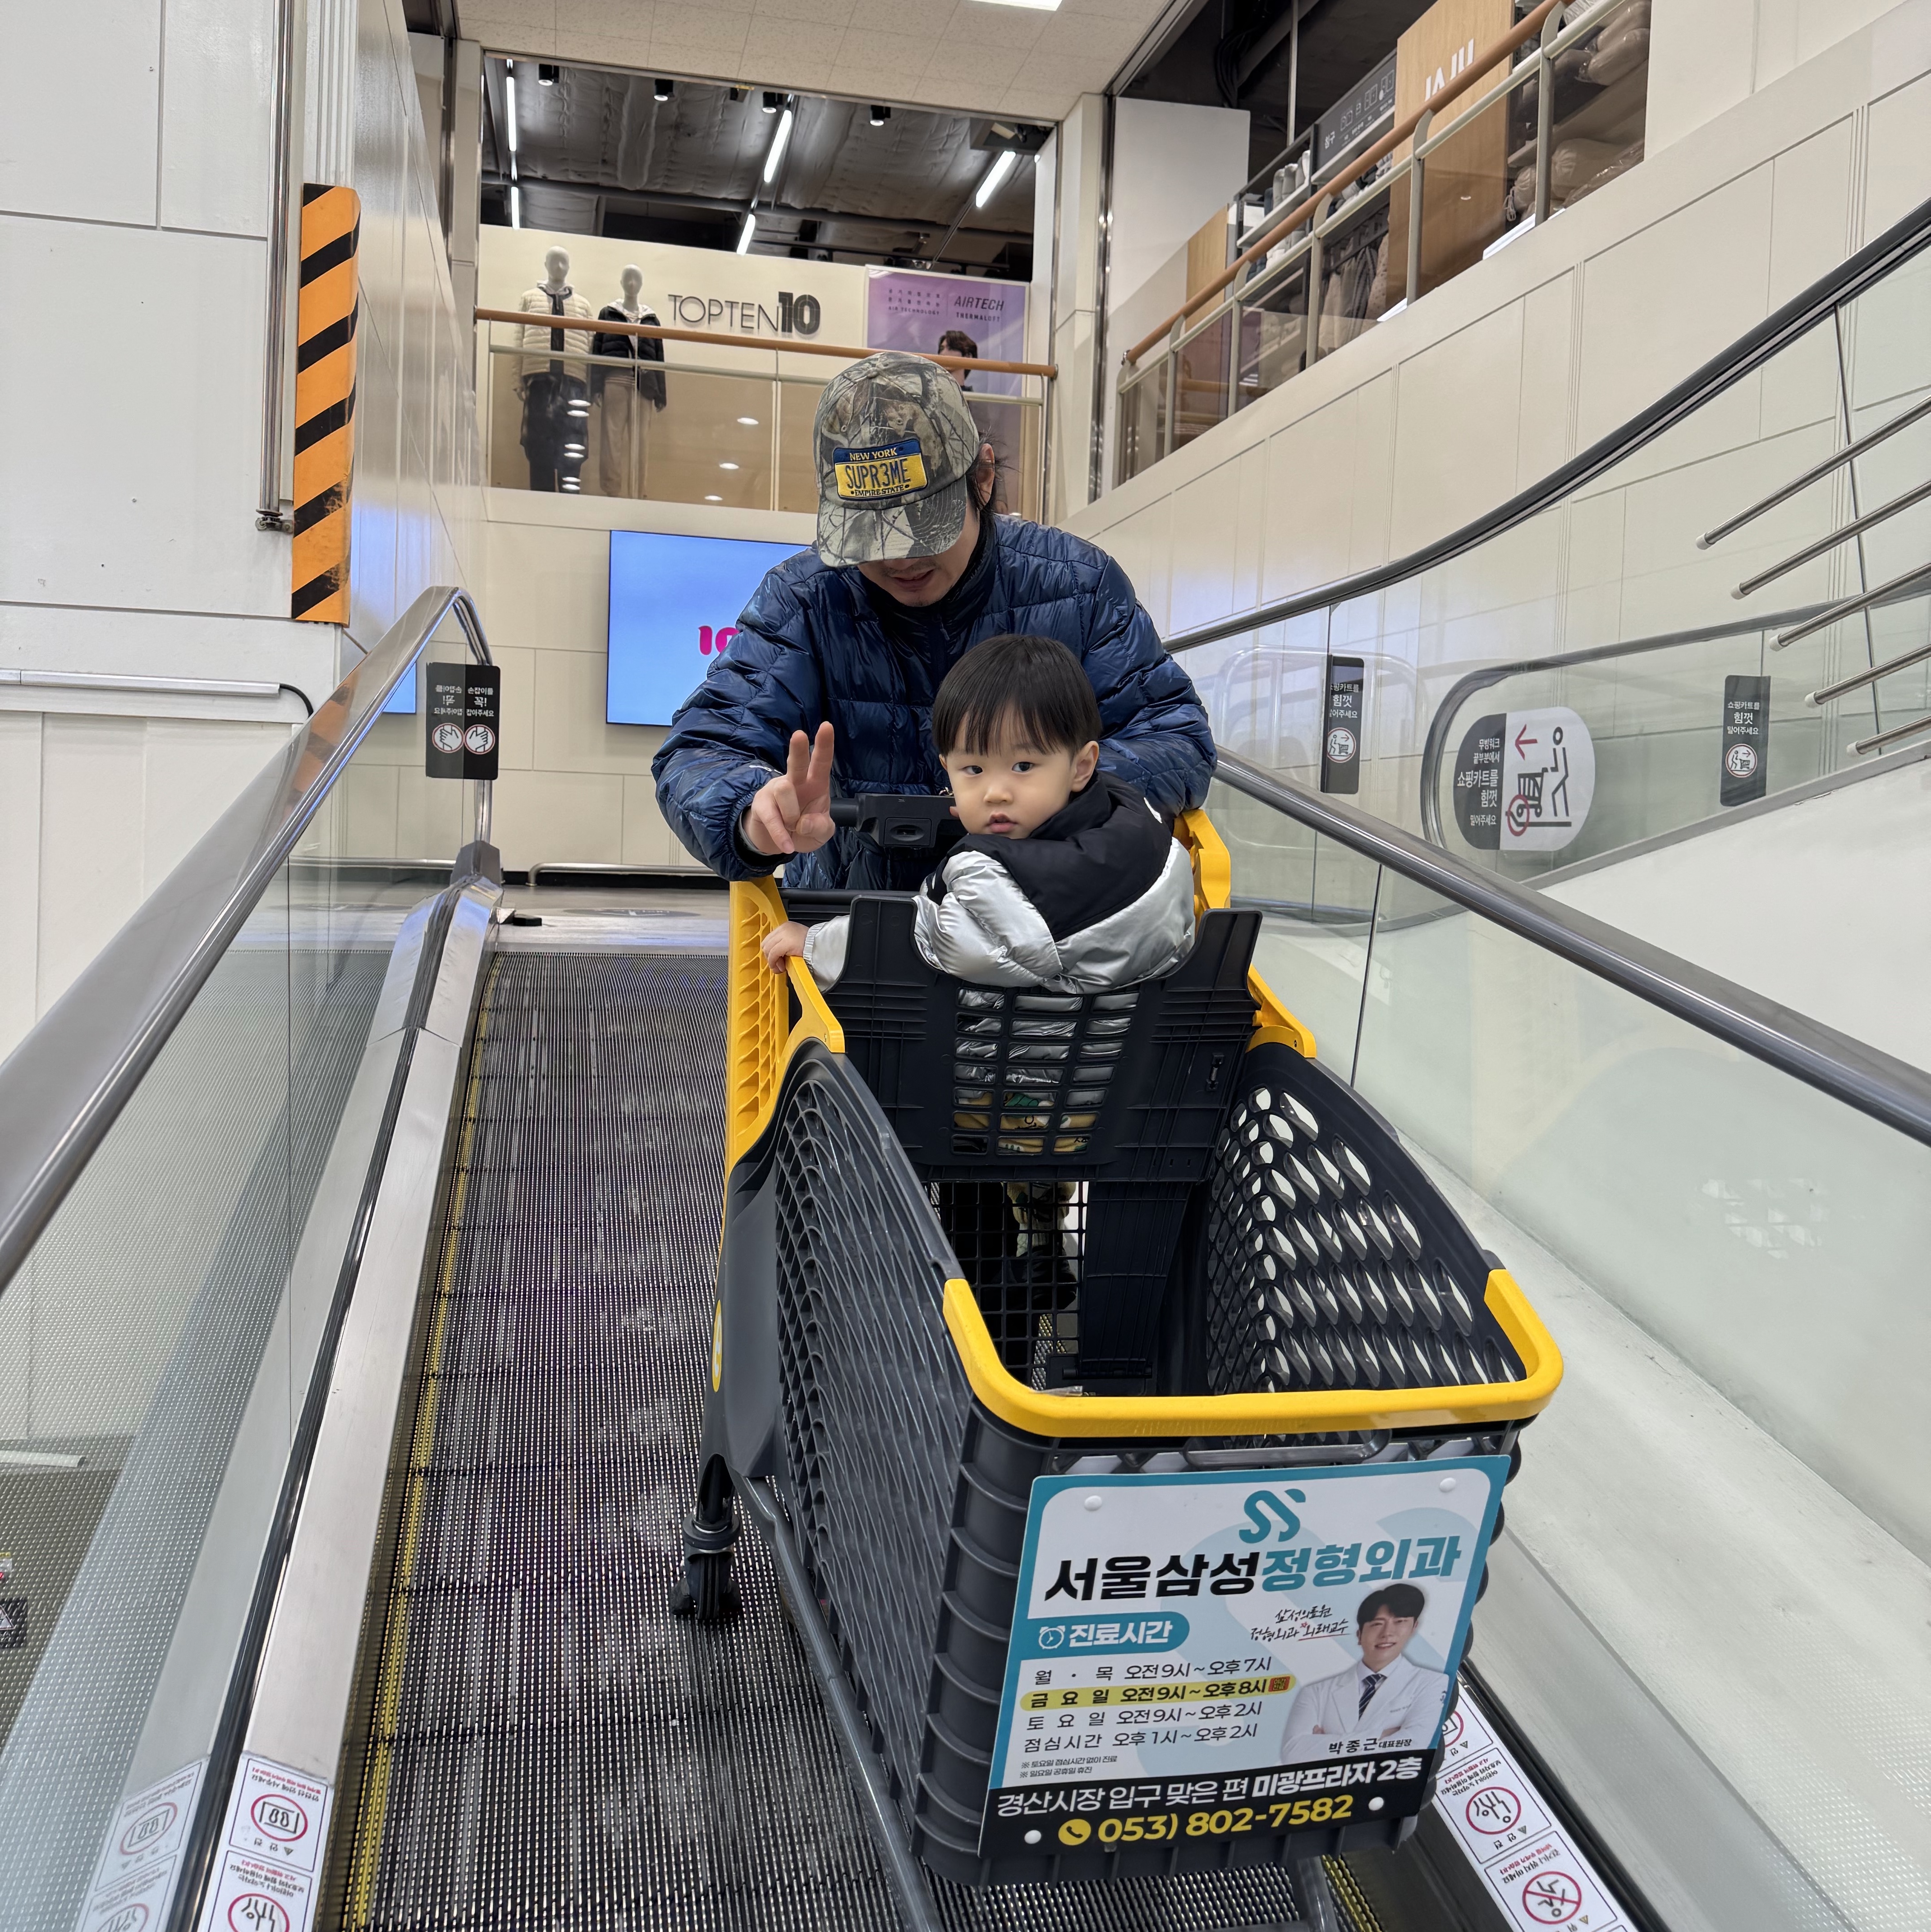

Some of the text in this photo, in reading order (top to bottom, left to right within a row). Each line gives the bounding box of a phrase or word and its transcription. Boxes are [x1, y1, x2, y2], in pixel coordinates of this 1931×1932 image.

[954, 296, 1004, 311] AIRTECH
[668, 291, 821, 335] TOPTEN10
[956, 312, 1000, 322] THERMALOFT
[850, 447, 897, 461] NEW YORK
[845, 458, 911, 489] SUPR3ME
[468, 687, 493, 695] 손잡이를
[474, 697, 487, 707] 꼭!
[1333, 694, 1352, 708] 힘껏
[1728, 702, 1760, 710] 쇼핑카트를
[466, 709, 494, 717] 잡아주세요
[1734, 712, 1753, 725] 힘껏
[1727, 726, 1758, 735] 밀어주세요
[1478, 738, 1500, 750] 무빙워크
[1473, 752, 1500, 764] 끝부분에서
[1457, 769, 1498, 788] 쇼핑카트를
[1481, 789, 1497, 807] 힘껏
[1470, 814, 1496, 826] 밀어주세요
[1275, 1604, 1333, 1624] 삼성의료원
[1069, 1620, 1172, 1647] 진료시간
[1251, 1627, 1299, 1642] 정형외과
[1035, 1670, 1052, 1685] 월
[1096, 1666, 1113, 1681] 목
[1025, 1734, 1102, 1753] 점심시간
[1378, 1739, 1412, 1748] 대표원장
[1031, 1760, 1054, 1768] 토요일
[1055, 1758, 1085, 1766] 점심시간
[1480, 1759, 1501, 1774] 보호자와
[1030, 1769, 1052, 1777] 일요일
[1054, 1767, 1076, 1775] 공휴일
[1475, 1769, 1498, 1784] 어린이나
[998, 1788, 1105, 1817] 경산시장
[1109, 1785, 1161, 1809] 입구
[1252, 1761, 1376, 1798] 미광프라자
[1377, 1757, 1422, 1781] 2층
[1440, 1777, 1467, 1795] 이용하세요
[1098, 1794, 1354, 1843] 053) 802-7582
[1502, 1868, 1524, 1884] 마세요
